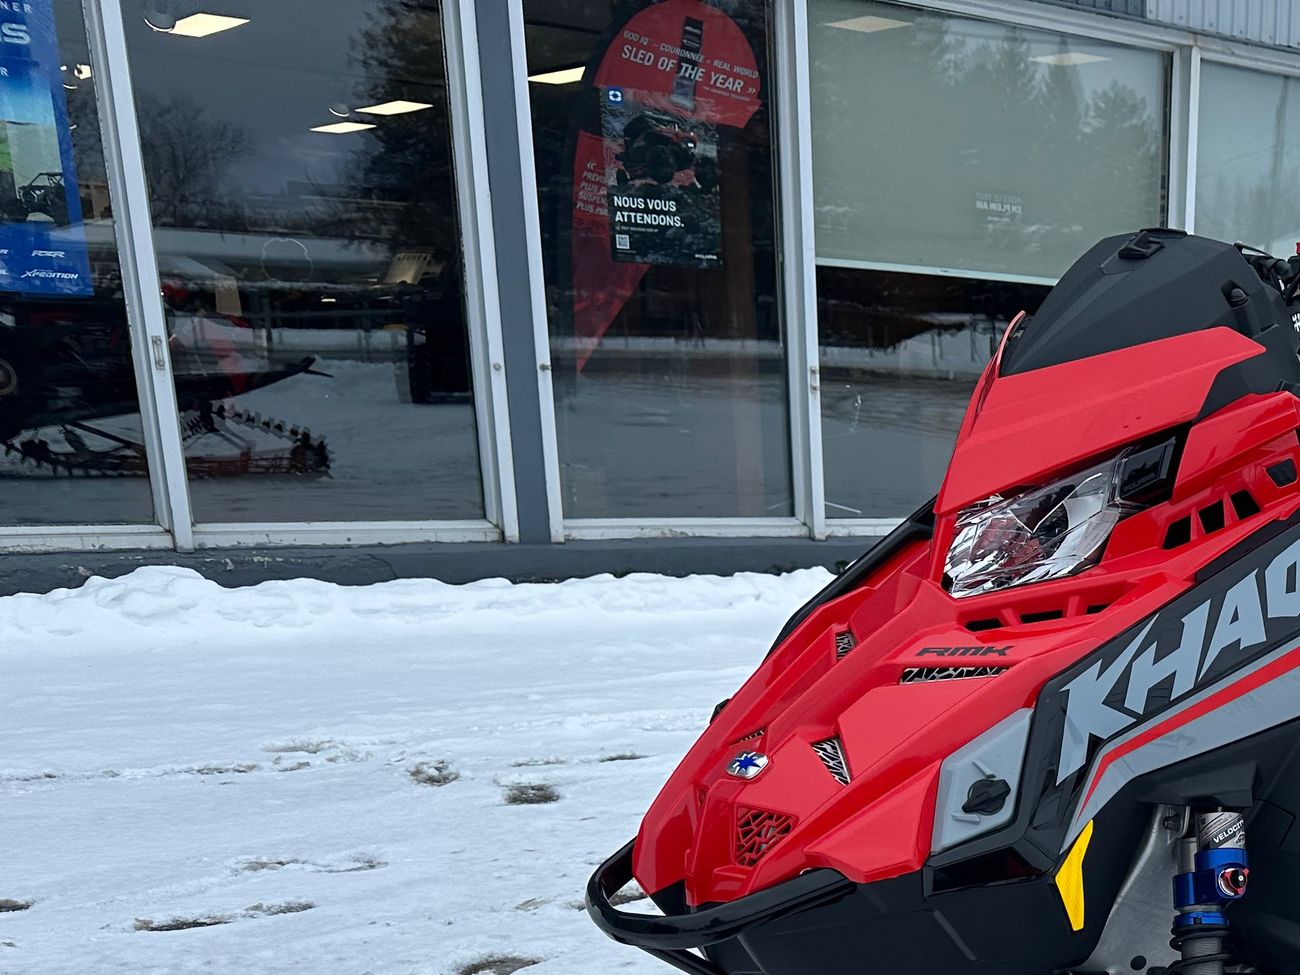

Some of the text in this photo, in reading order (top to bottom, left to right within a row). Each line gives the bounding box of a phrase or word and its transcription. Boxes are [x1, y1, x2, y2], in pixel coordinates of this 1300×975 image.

[621, 44, 655, 66] SLED
[657, 56, 677, 73] OF
[679, 62, 706, 82] THE
[710, 71, 744, 94] YEAR
[613, 195, 676, 212] NOUS VOUS
[615, 211, 685, 227] ATTENDONS.
[20, 269, 79, 279] XPEDITION
[915, 645, 1015, 657] RMK
[1213, 819, 1244, 844] VELOCIT
